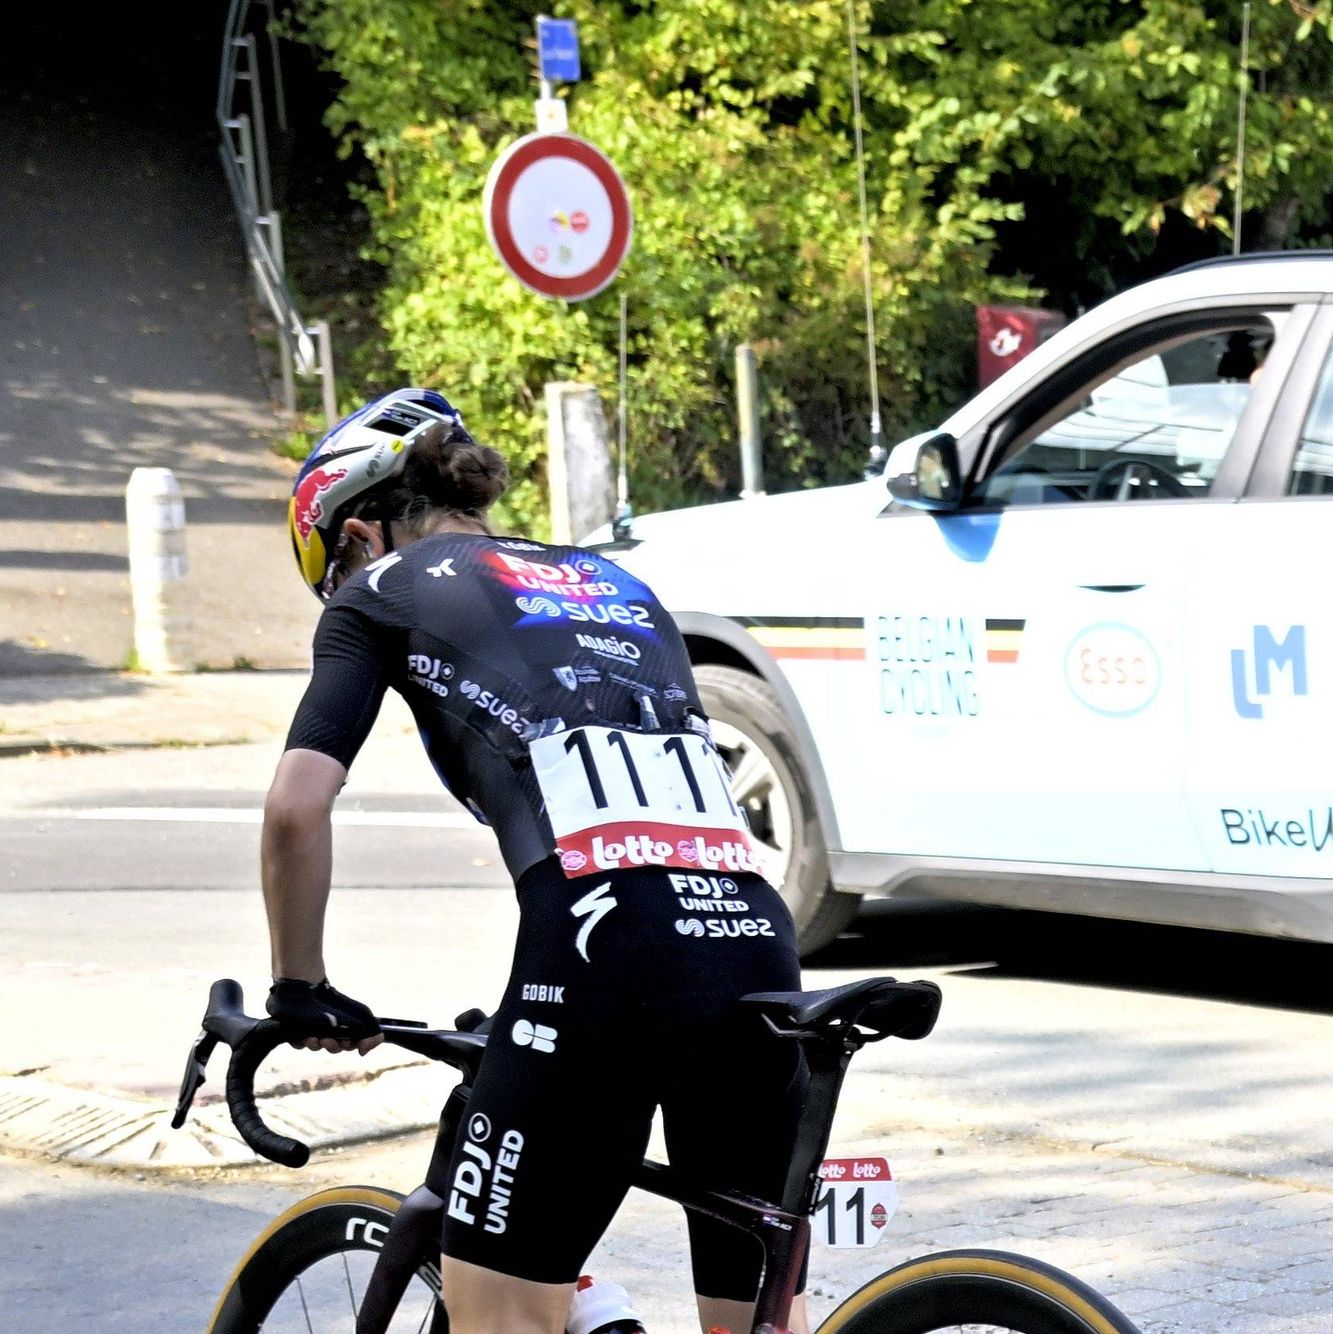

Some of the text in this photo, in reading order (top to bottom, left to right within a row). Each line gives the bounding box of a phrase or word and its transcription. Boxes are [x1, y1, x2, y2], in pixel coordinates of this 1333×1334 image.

[496, 552, 582, 584] FDJ
[516, 576, 619, 597] UNITED
[408, 654, 441, 679] FDJ
[667, 874, 724, 898] FDJ
[678, 897, 750, 913] UNITED
[522, 984, 566, 1004] GOBIK
[447, 1140, 492, 1225] FDJ
[484, 1129, 524, 1235] UNITED
[817, 1187, 864, 1245] 11
